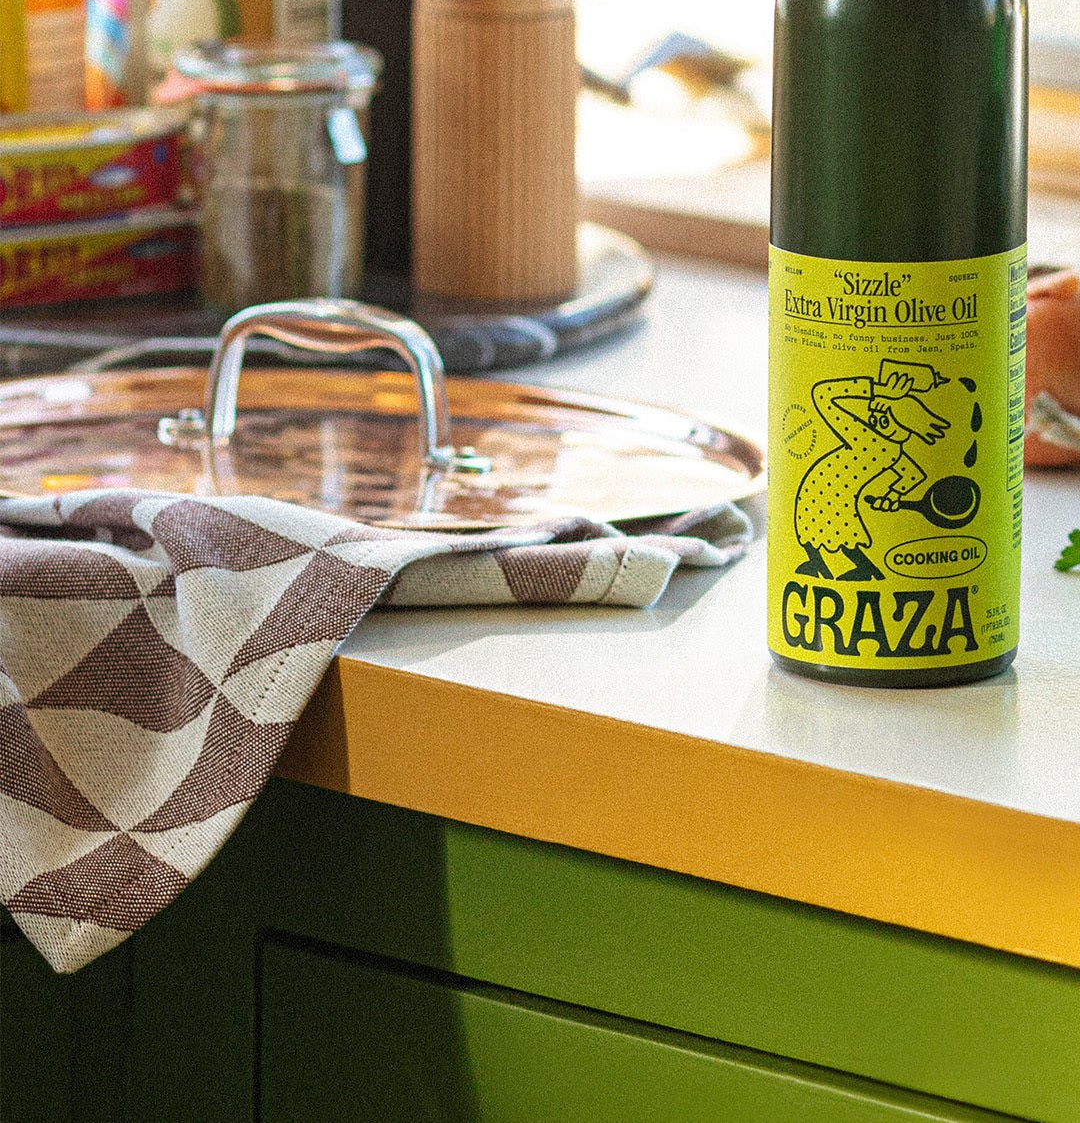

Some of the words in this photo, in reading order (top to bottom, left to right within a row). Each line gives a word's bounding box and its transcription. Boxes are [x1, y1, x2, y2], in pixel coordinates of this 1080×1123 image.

[784, 288, 822, 318] Extra
[826, 296, 888, 328] Virgin
[894, 297, 946, 323] Olive
[951, 293, 978, 319] Oil
[793, 325, 828, 339] blending,
[849, 333, 875, 343] funny
[881, 334, 928, 343] business.
[934, 333, 955, 341] Just
[960, 330, 979, 339] 100%
[784, 335, 797, 344] pure
[801, 337, 826, 349] Picual
[832, 343, 857, 352] olive
[863, 345, 879, 353] oil
[887, 345, 910, 353] from
[949, 342, 977, 352] Spain.
[893, 550, 958, 566] COOKING
[961, 546, 981, 561] OIL
